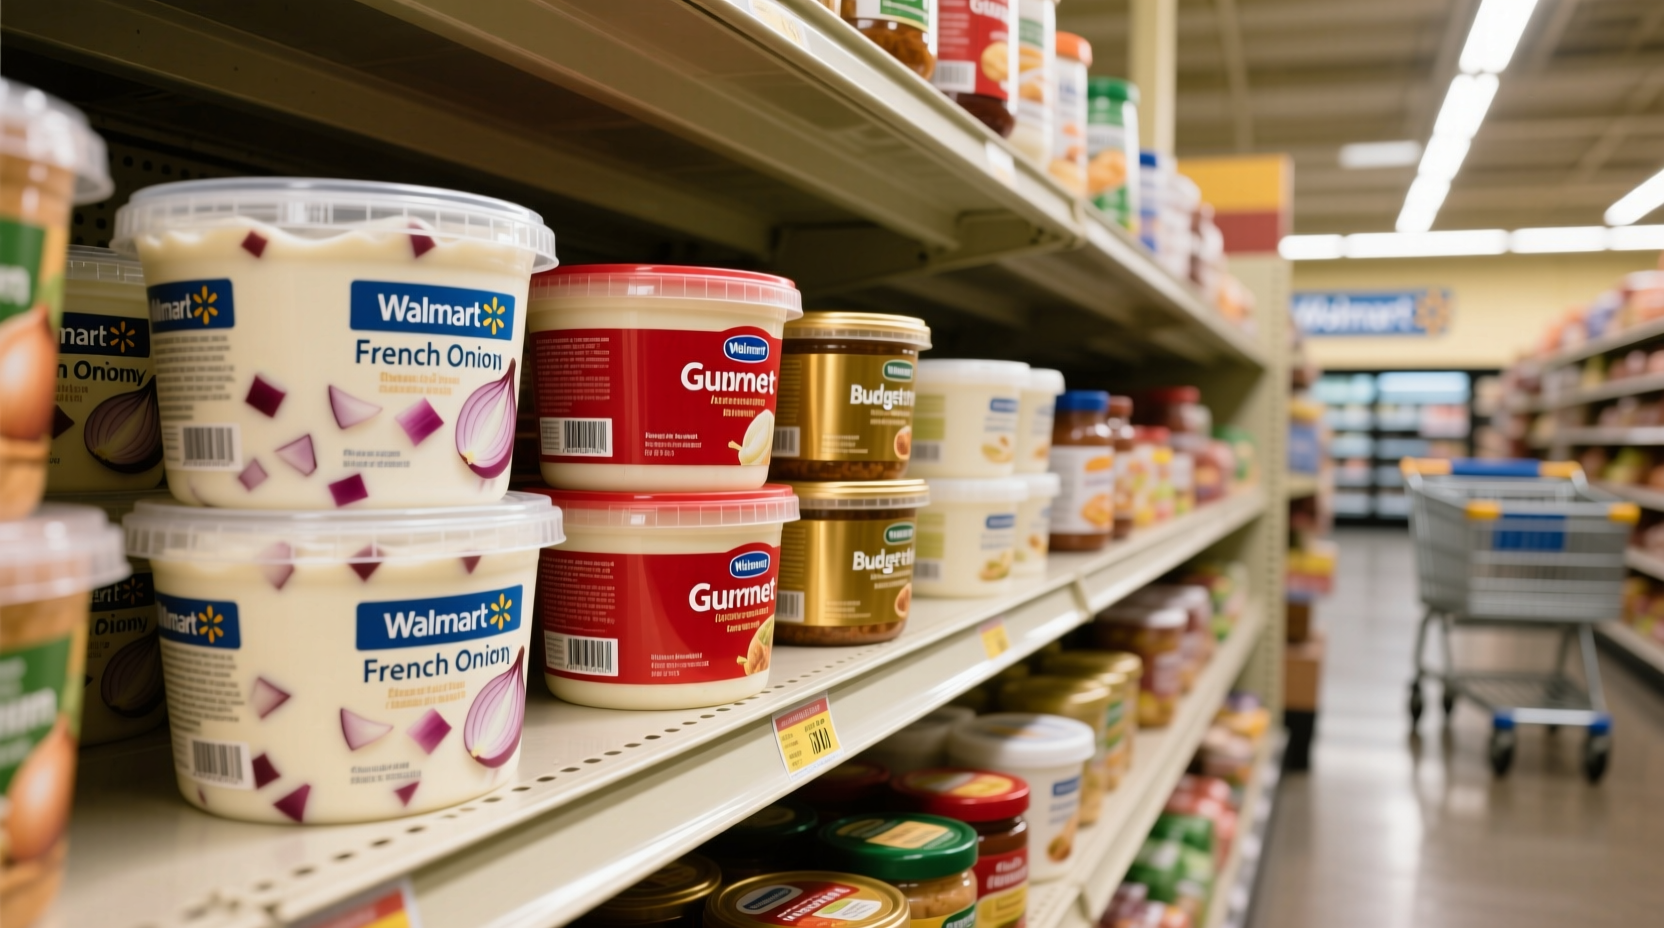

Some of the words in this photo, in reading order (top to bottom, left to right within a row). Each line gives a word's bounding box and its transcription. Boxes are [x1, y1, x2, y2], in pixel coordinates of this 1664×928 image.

[377, 293, 482, 328] Walmart
[355, 339, 440, 366] French
[447, 344, 502, 371] Onion
[383, 603, 489, 639] Walmart
[363, 653, 448, 683] French
